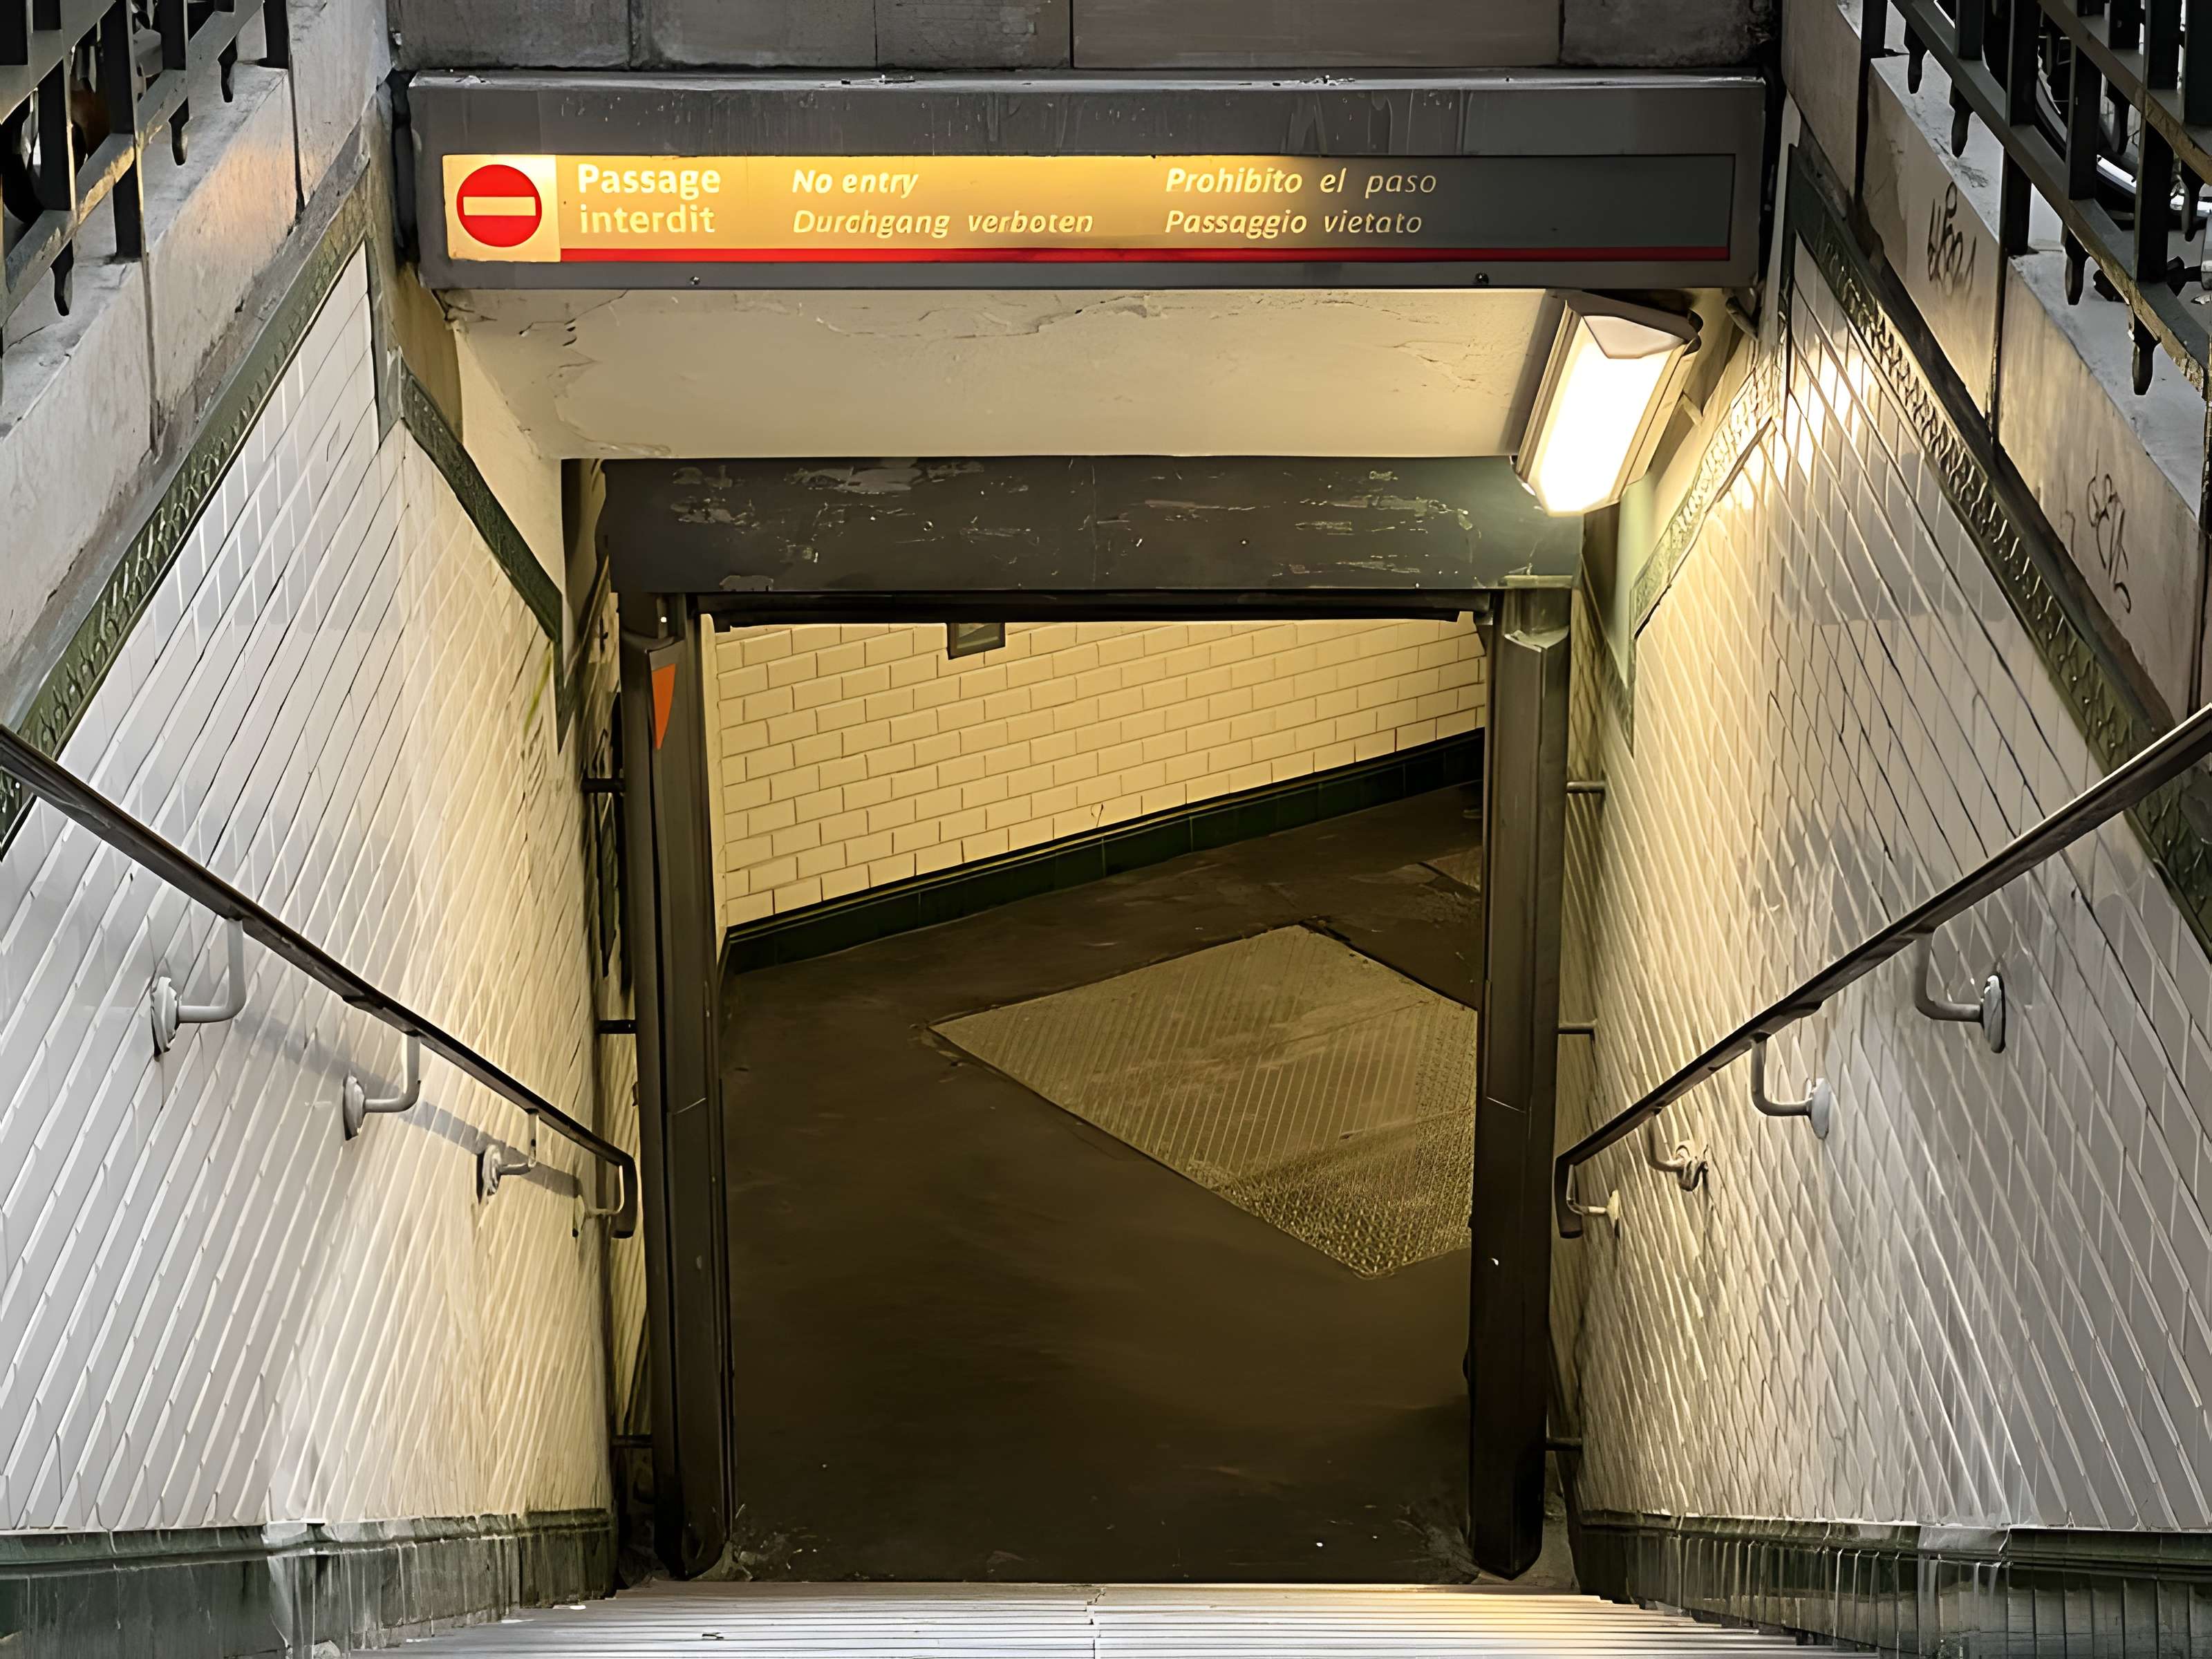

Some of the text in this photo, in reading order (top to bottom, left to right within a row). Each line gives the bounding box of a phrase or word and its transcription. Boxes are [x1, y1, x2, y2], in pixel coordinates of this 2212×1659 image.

[578, 163, 720, 200] Passage
[791, 169, 919, 199] No entry
[1165, 167, 1437, 199] Prohibito el paso
[580, 203, 716, 234] interdit
[968, 209, 1094, 234] verboten
[1165, 209, 1423, 239] Passaggio vietato
